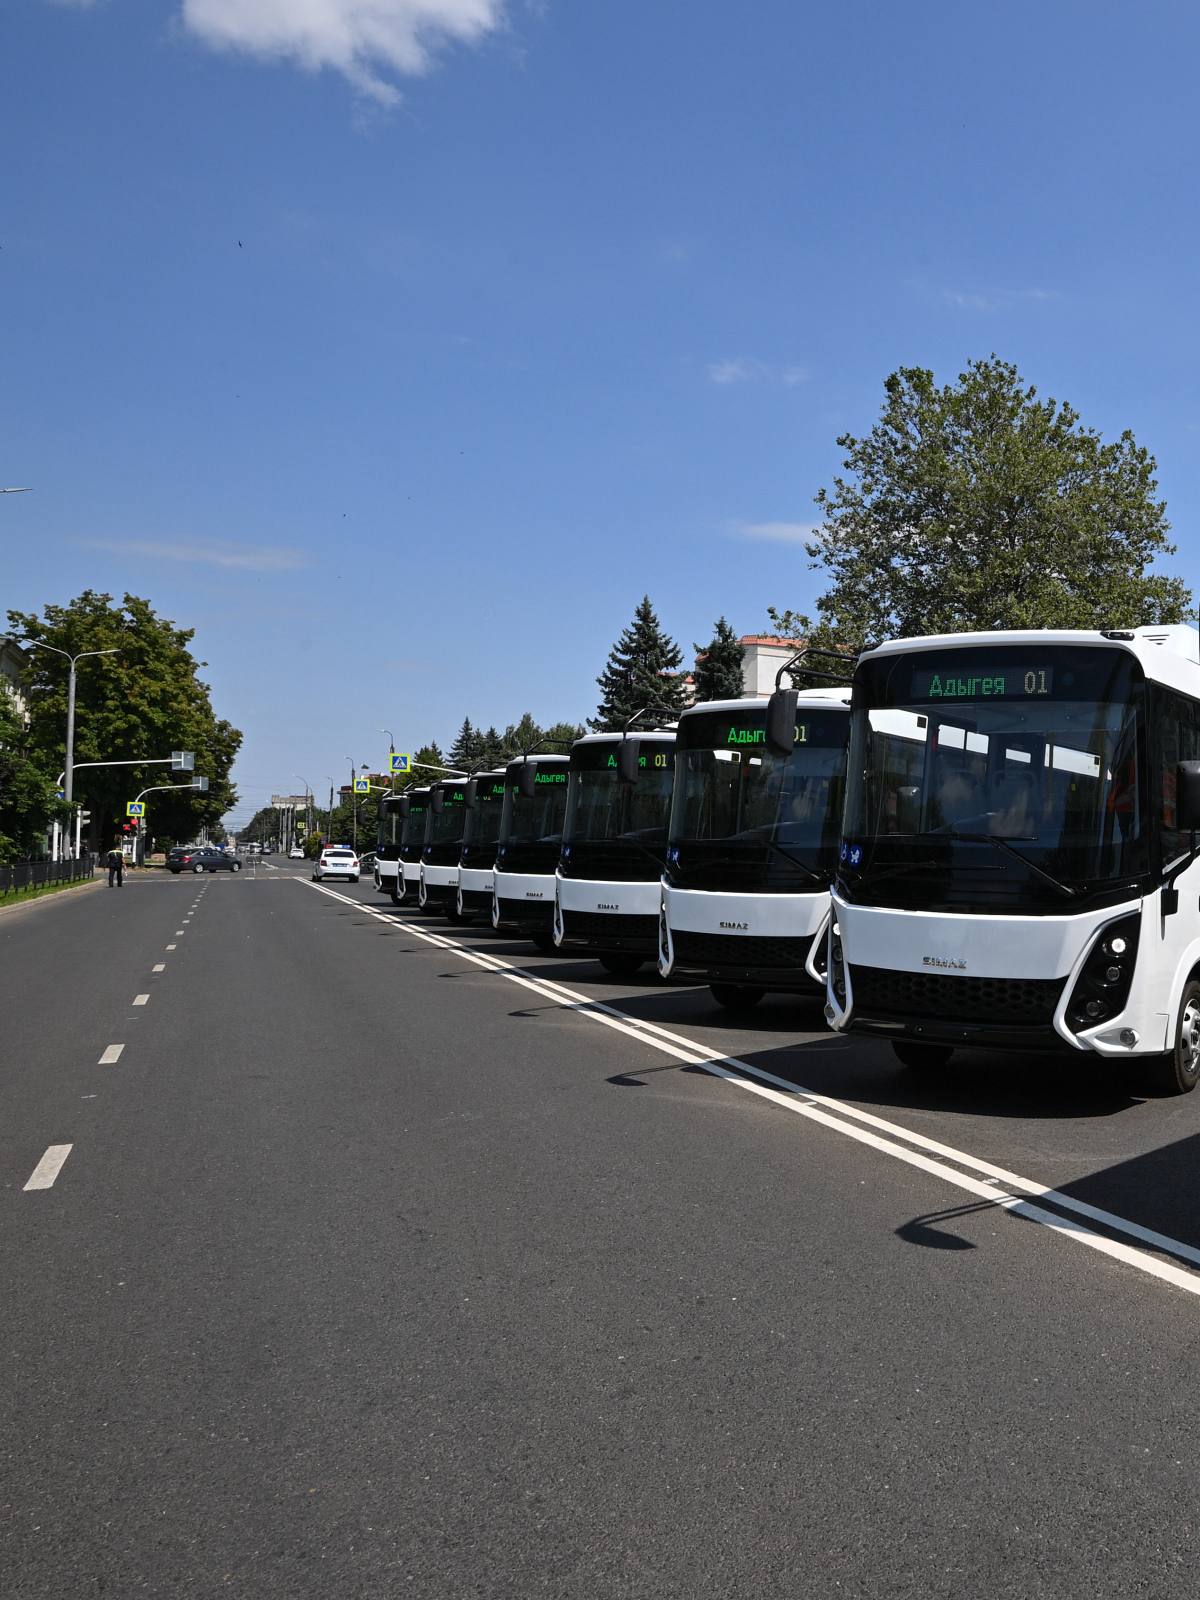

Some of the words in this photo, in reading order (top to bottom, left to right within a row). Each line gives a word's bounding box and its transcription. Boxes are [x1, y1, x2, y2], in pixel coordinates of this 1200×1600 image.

[929, 674, 1005, 697] Адыгея
[1024, 670, 1048, 694] 01
[655, 754, 667, 767] 01
[534, 772, 566, 783] Адыгея
[719, 921, 749, 930] SIMAZ
[922, 956, 967, 969] SIMAZ
